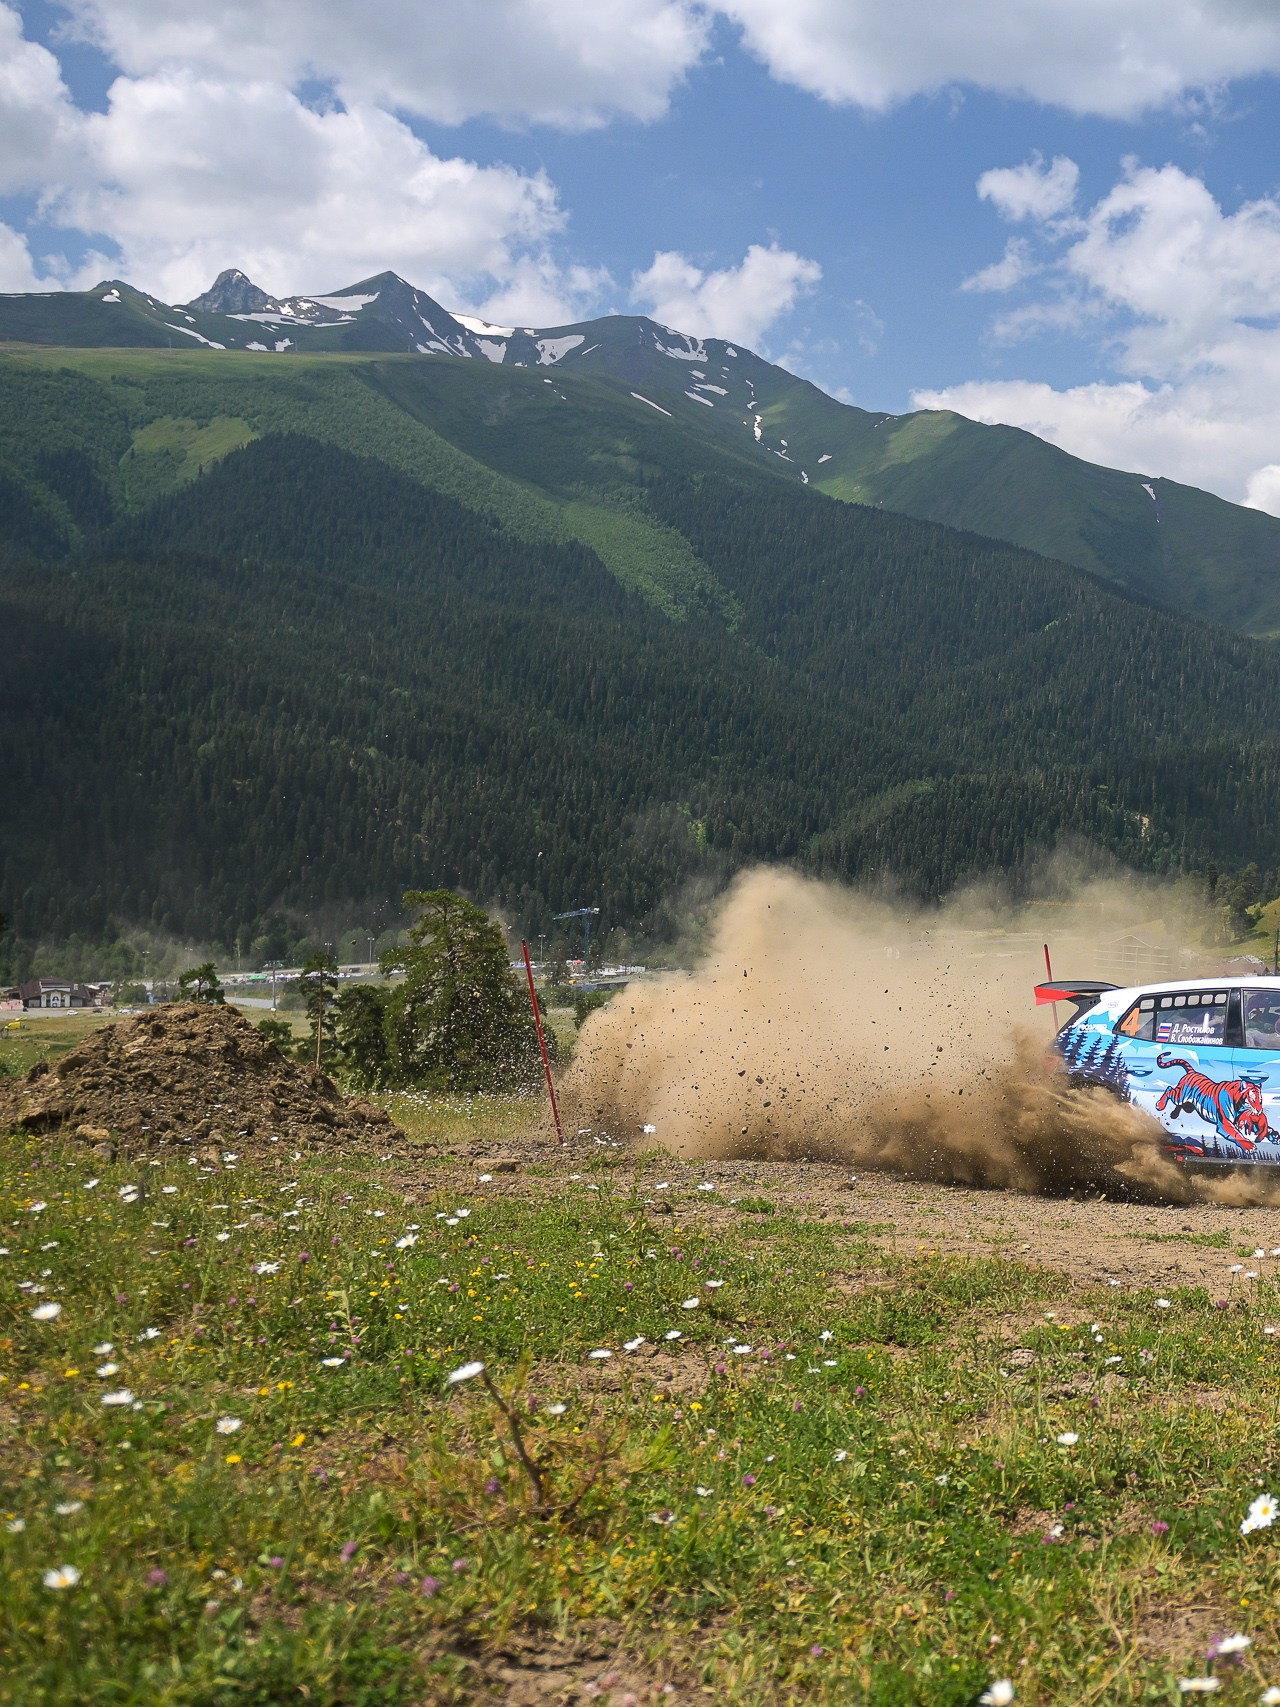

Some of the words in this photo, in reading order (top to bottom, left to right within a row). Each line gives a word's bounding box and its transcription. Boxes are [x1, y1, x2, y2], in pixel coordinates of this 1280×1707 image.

[1120, 1007, 1141, 1036] 4
[1172, 1024, 1180, 1034] Д.
[1170, 1034, 1176, 1042] В.
